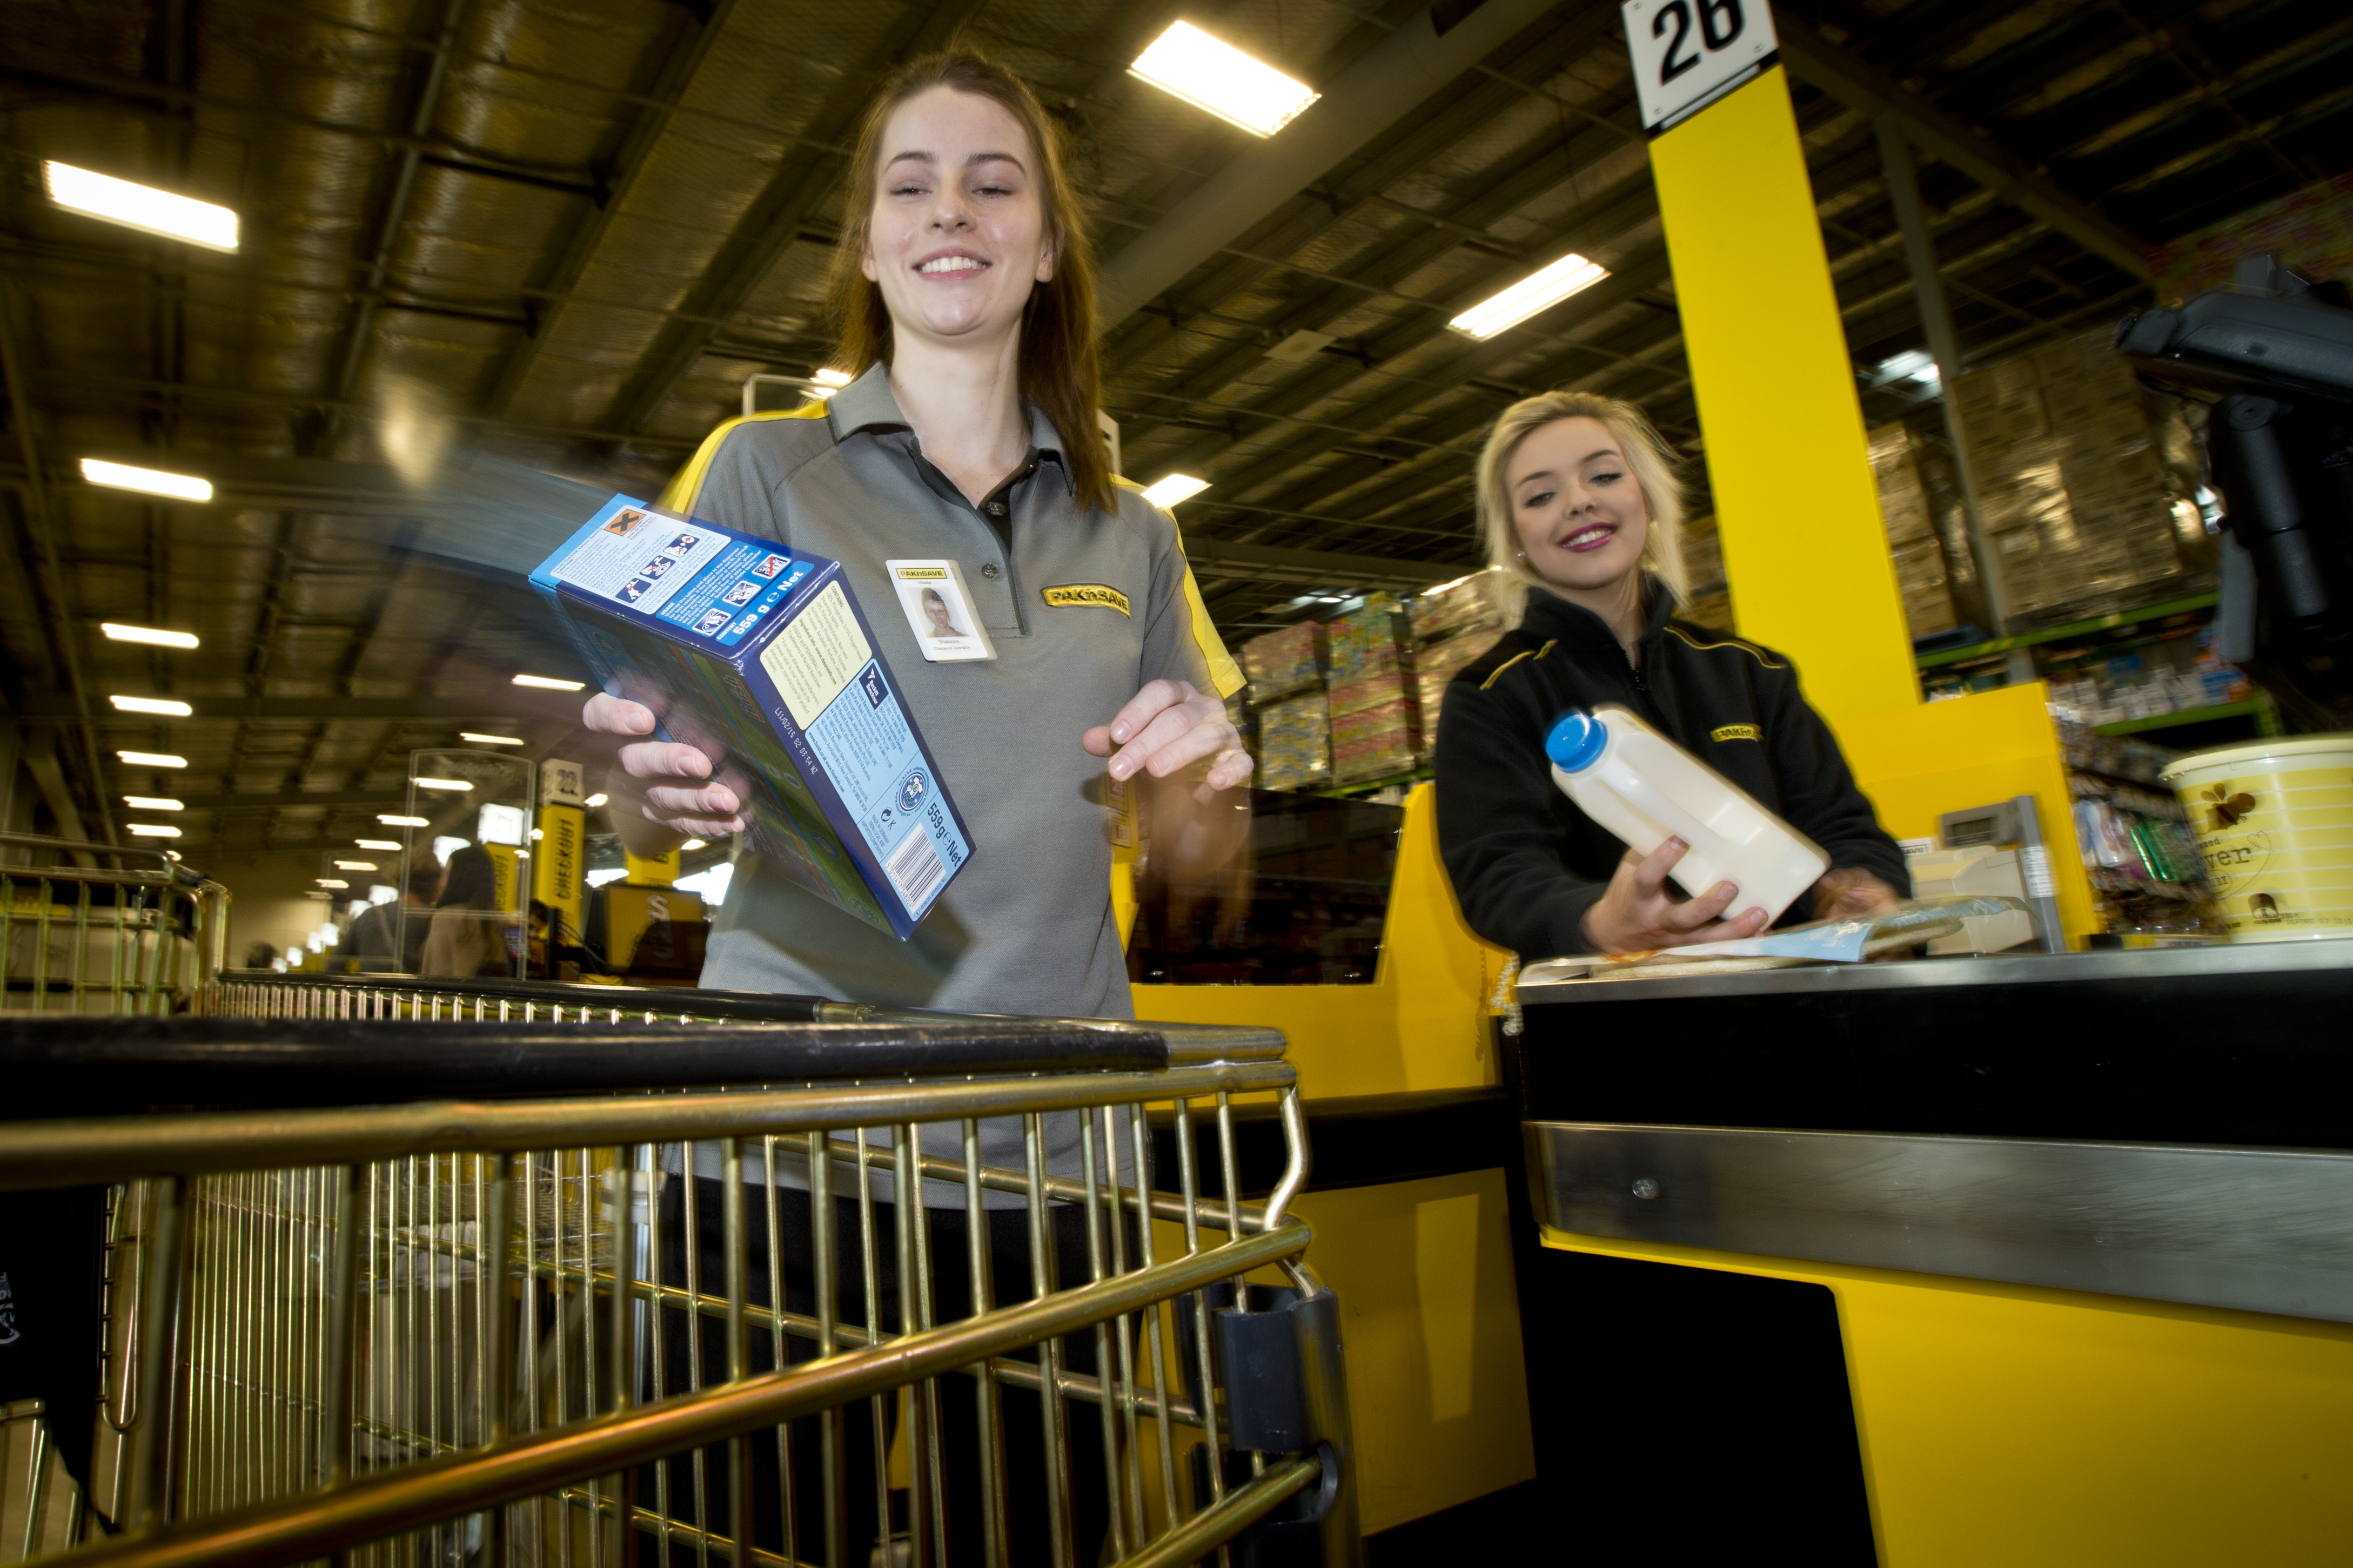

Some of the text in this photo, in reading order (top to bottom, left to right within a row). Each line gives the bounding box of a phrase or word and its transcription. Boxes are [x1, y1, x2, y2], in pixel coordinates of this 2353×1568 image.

[660, 602, 676, 615] USAGE
[731, 613, 760, 635] 559
[755, 604, 772, 614] g
[776, 569, 805, 591] Net
[716, 621, 738, 640] CONTENT
[865, 683, 879, 705] Benckiser
[869, 679, 879, 697] Reckitt
[871, 813, 879, 826] MADE
[879, 826, 889, 844] GERMANY
[887, 818, 896, 831] K
[926, 801, 944, 830] 559
[935, 824, 946, 840] g
[946, 839, 963, 868] Net
[554, 818, 575, 900] CHECKOUT
[2203, 846, 2251, 869] ver
[888, 867, 902, 890] 011417
[900, 887, 913, 908] 548004
